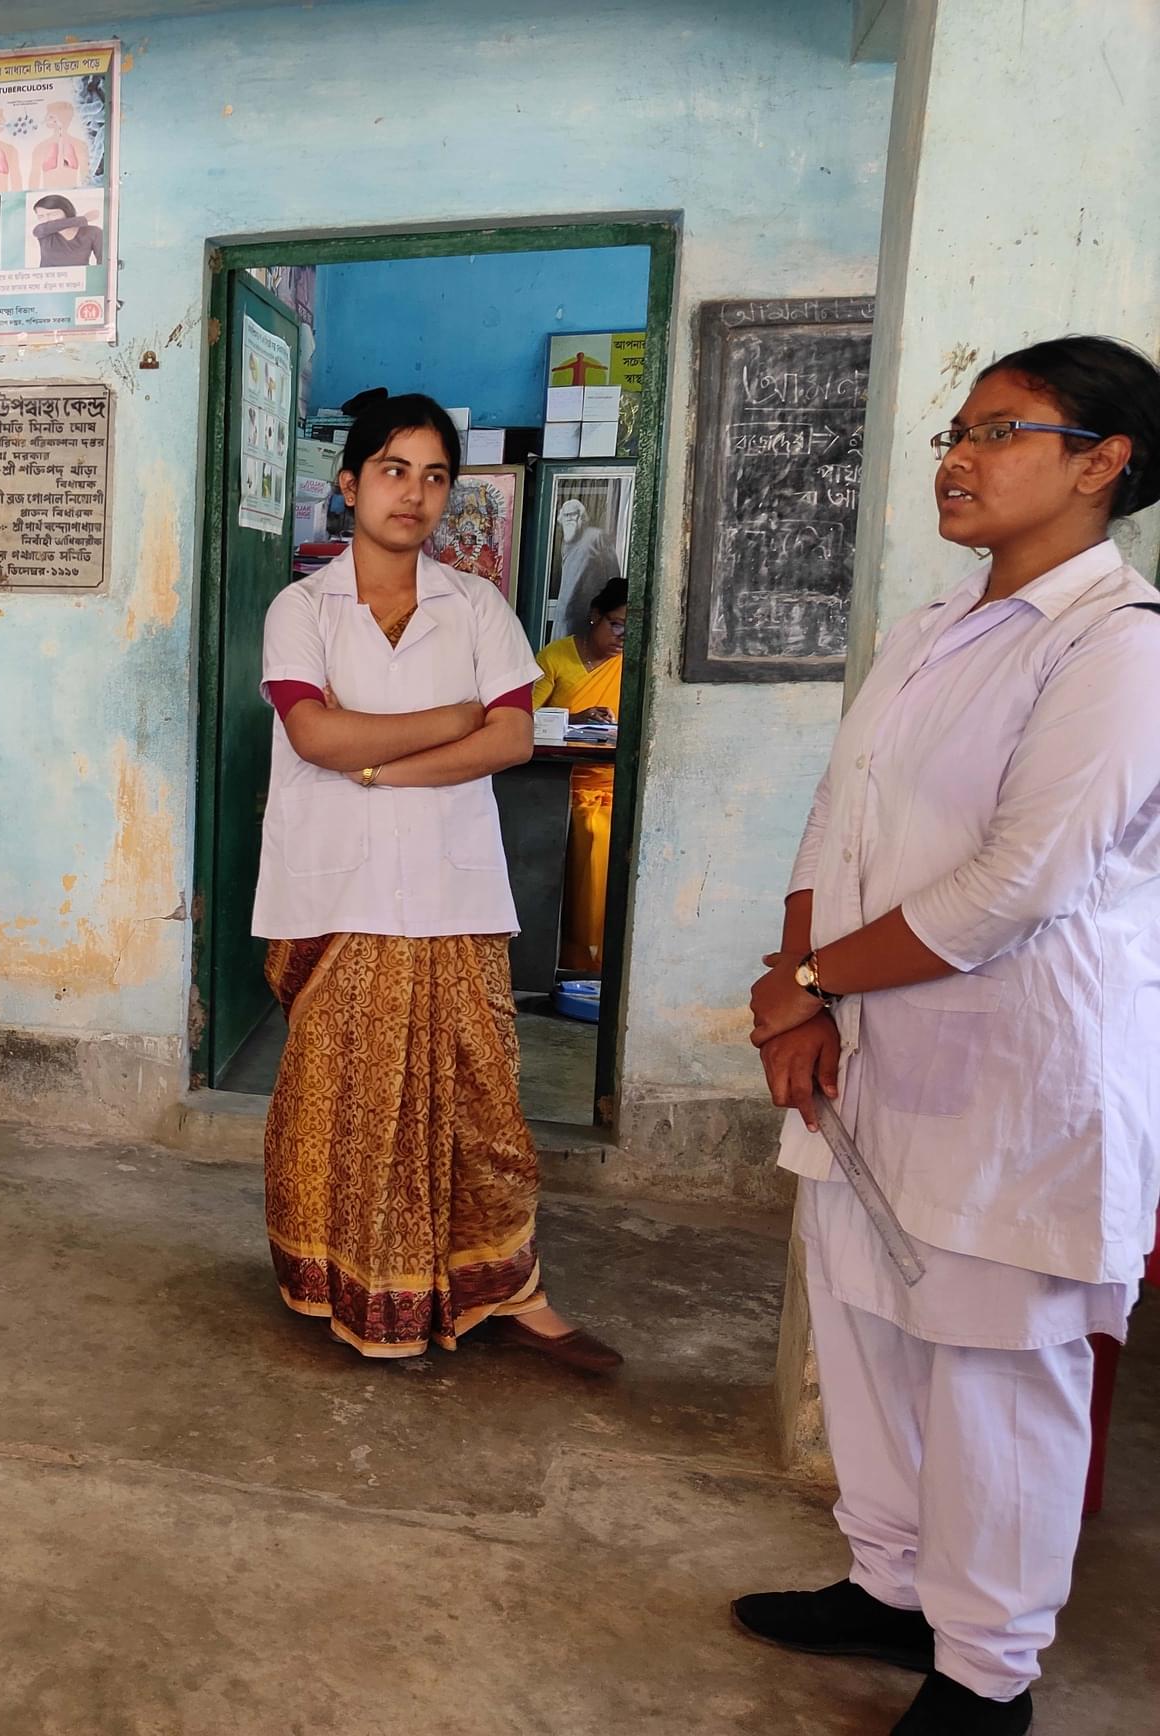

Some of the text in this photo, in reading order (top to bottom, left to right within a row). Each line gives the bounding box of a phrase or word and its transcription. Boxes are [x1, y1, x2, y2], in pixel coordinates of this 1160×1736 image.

[34, 60, 51, 72] টিবি
[29, 419, 64, 433] মিনতি
[70, 422, 96, 433] ঘোষ
[27, 492, 63, 504] গোপাল
